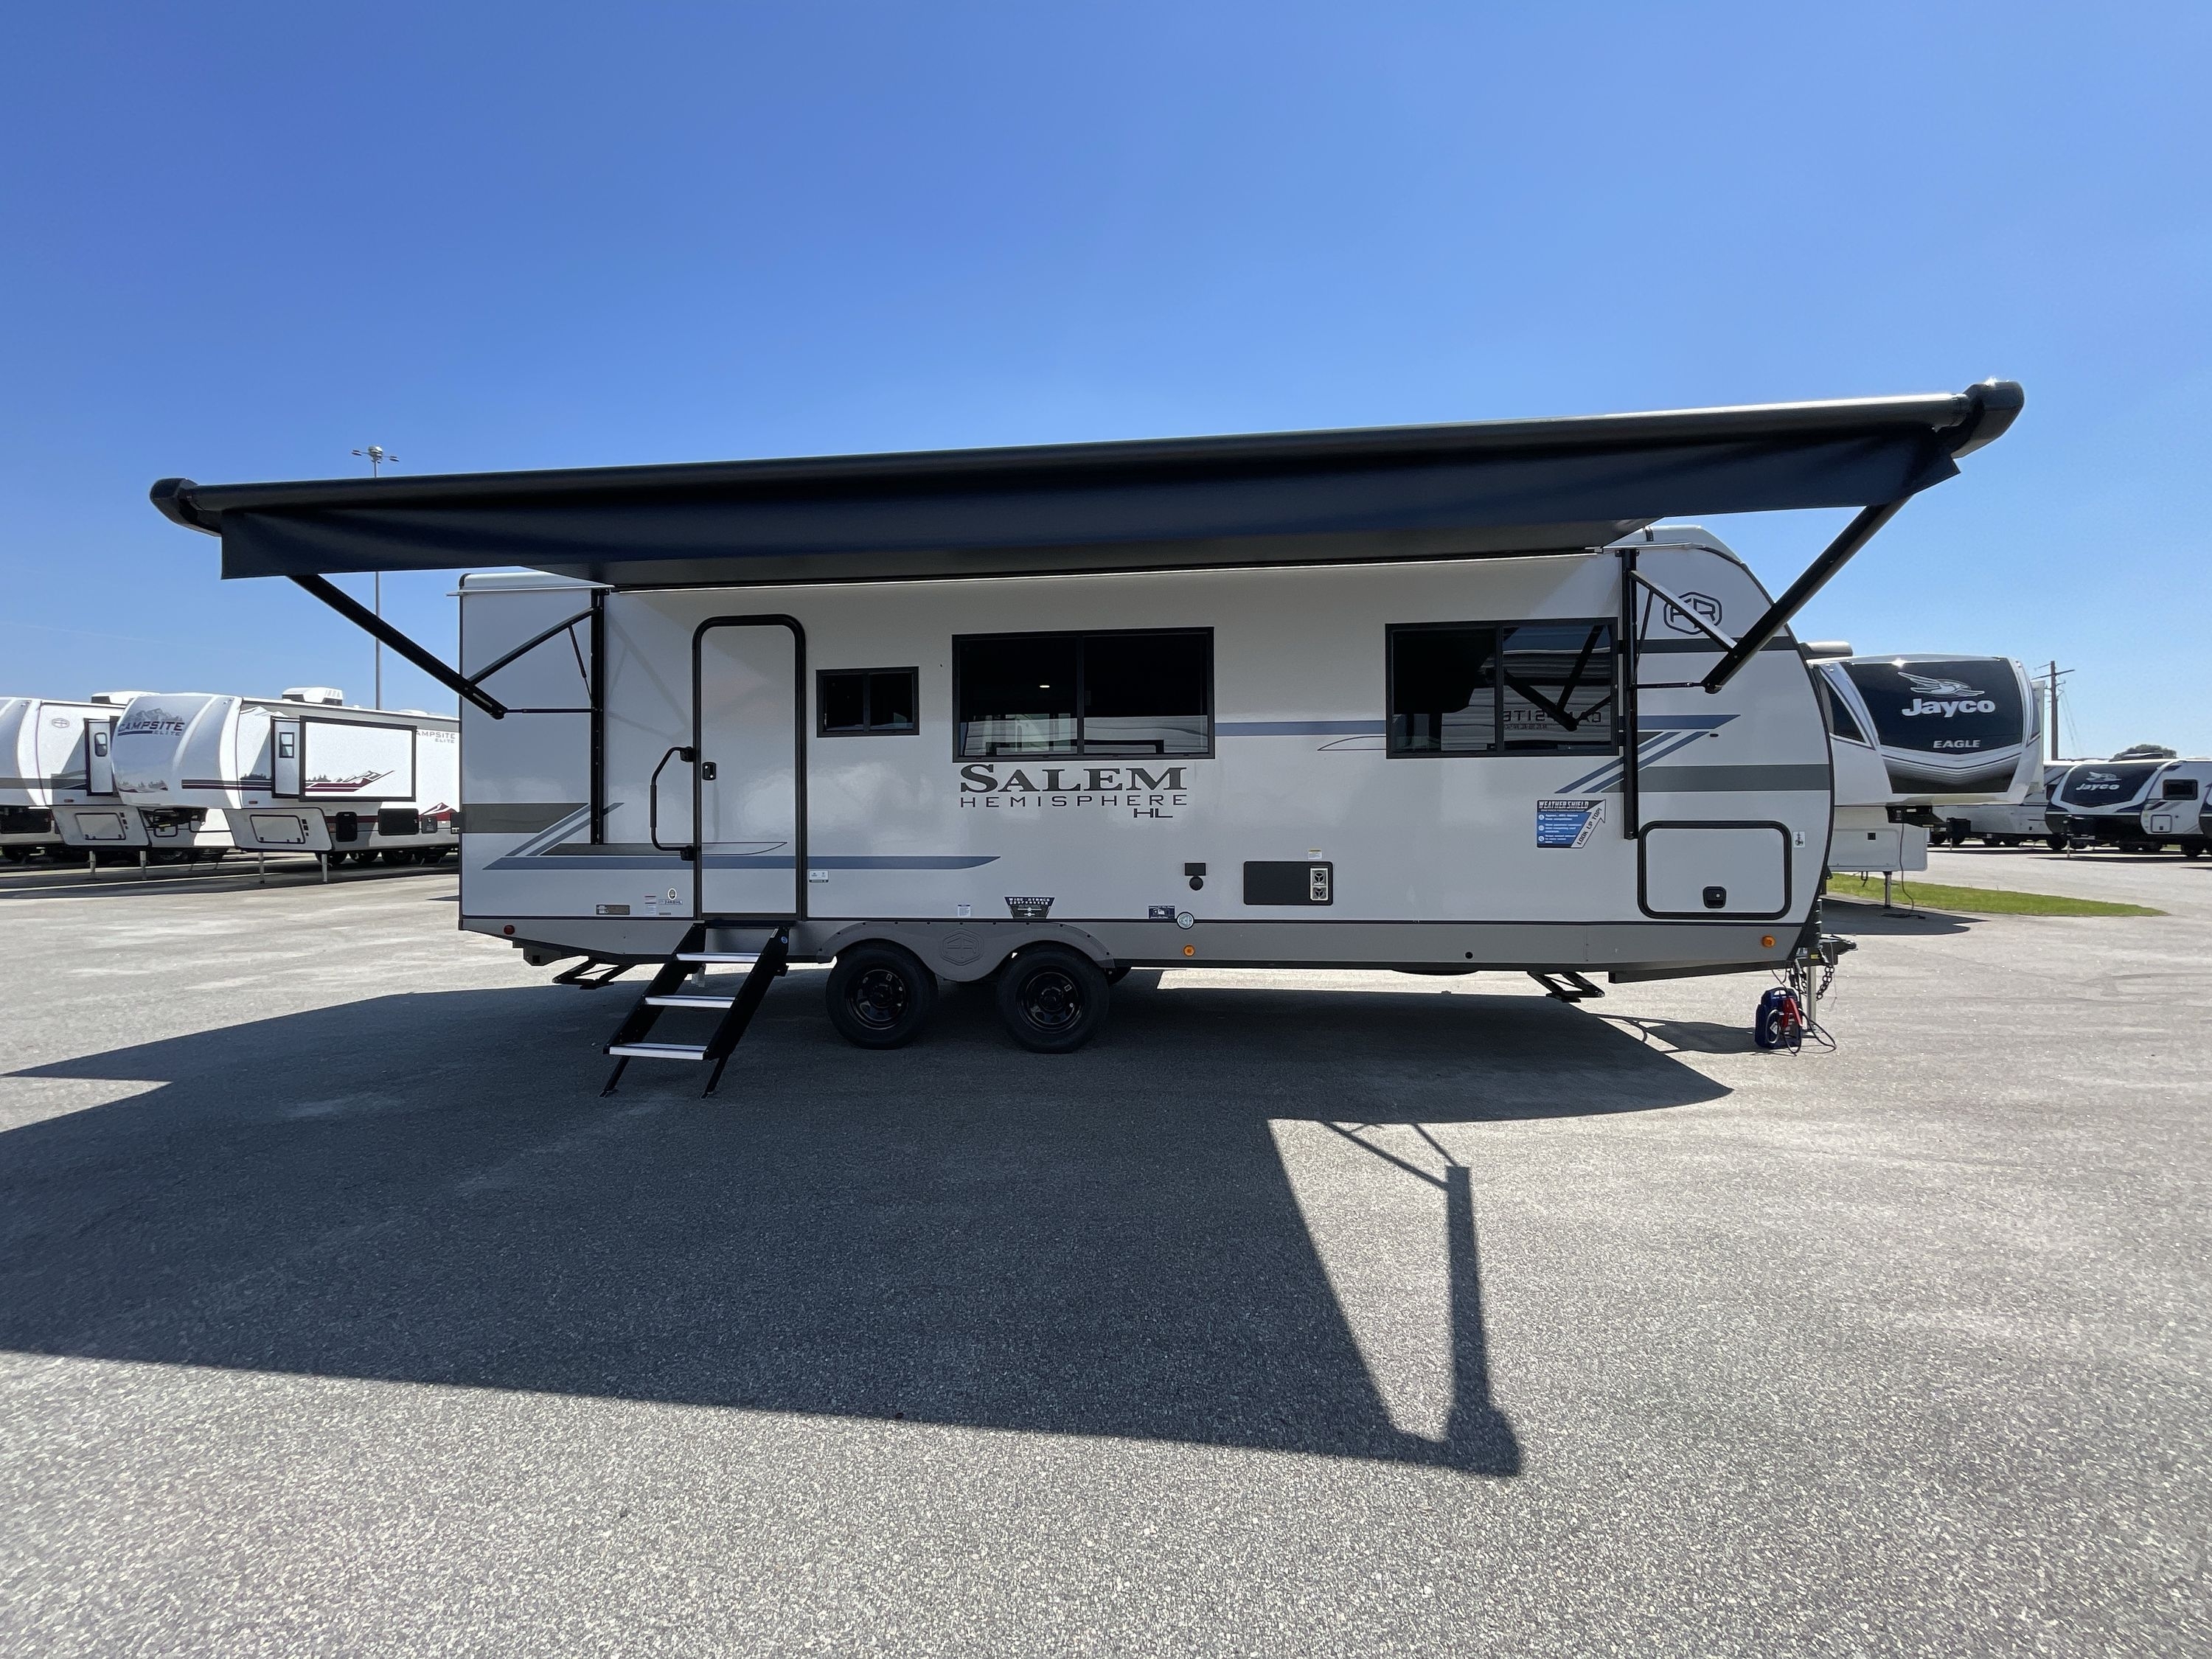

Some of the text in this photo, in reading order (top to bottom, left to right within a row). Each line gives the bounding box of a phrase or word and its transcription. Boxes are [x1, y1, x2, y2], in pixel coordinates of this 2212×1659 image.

[1902, 698, 1995, 717] Jayco
[118, 721, 184, 731] CAMPSITE
[416, 731, 456, 739] AMPSITE
[1933, 740, 1981, 748] EAGLE
[960, 764, 1187, 793] SALEM
[2076, 783, 2120, 791] Jayco
[960, 794, 1187, 807] HEMISPHERE
[1133, 807, 1173, 818] HL
[1576, 807, 1602, 845] LOOK UP TOP!
